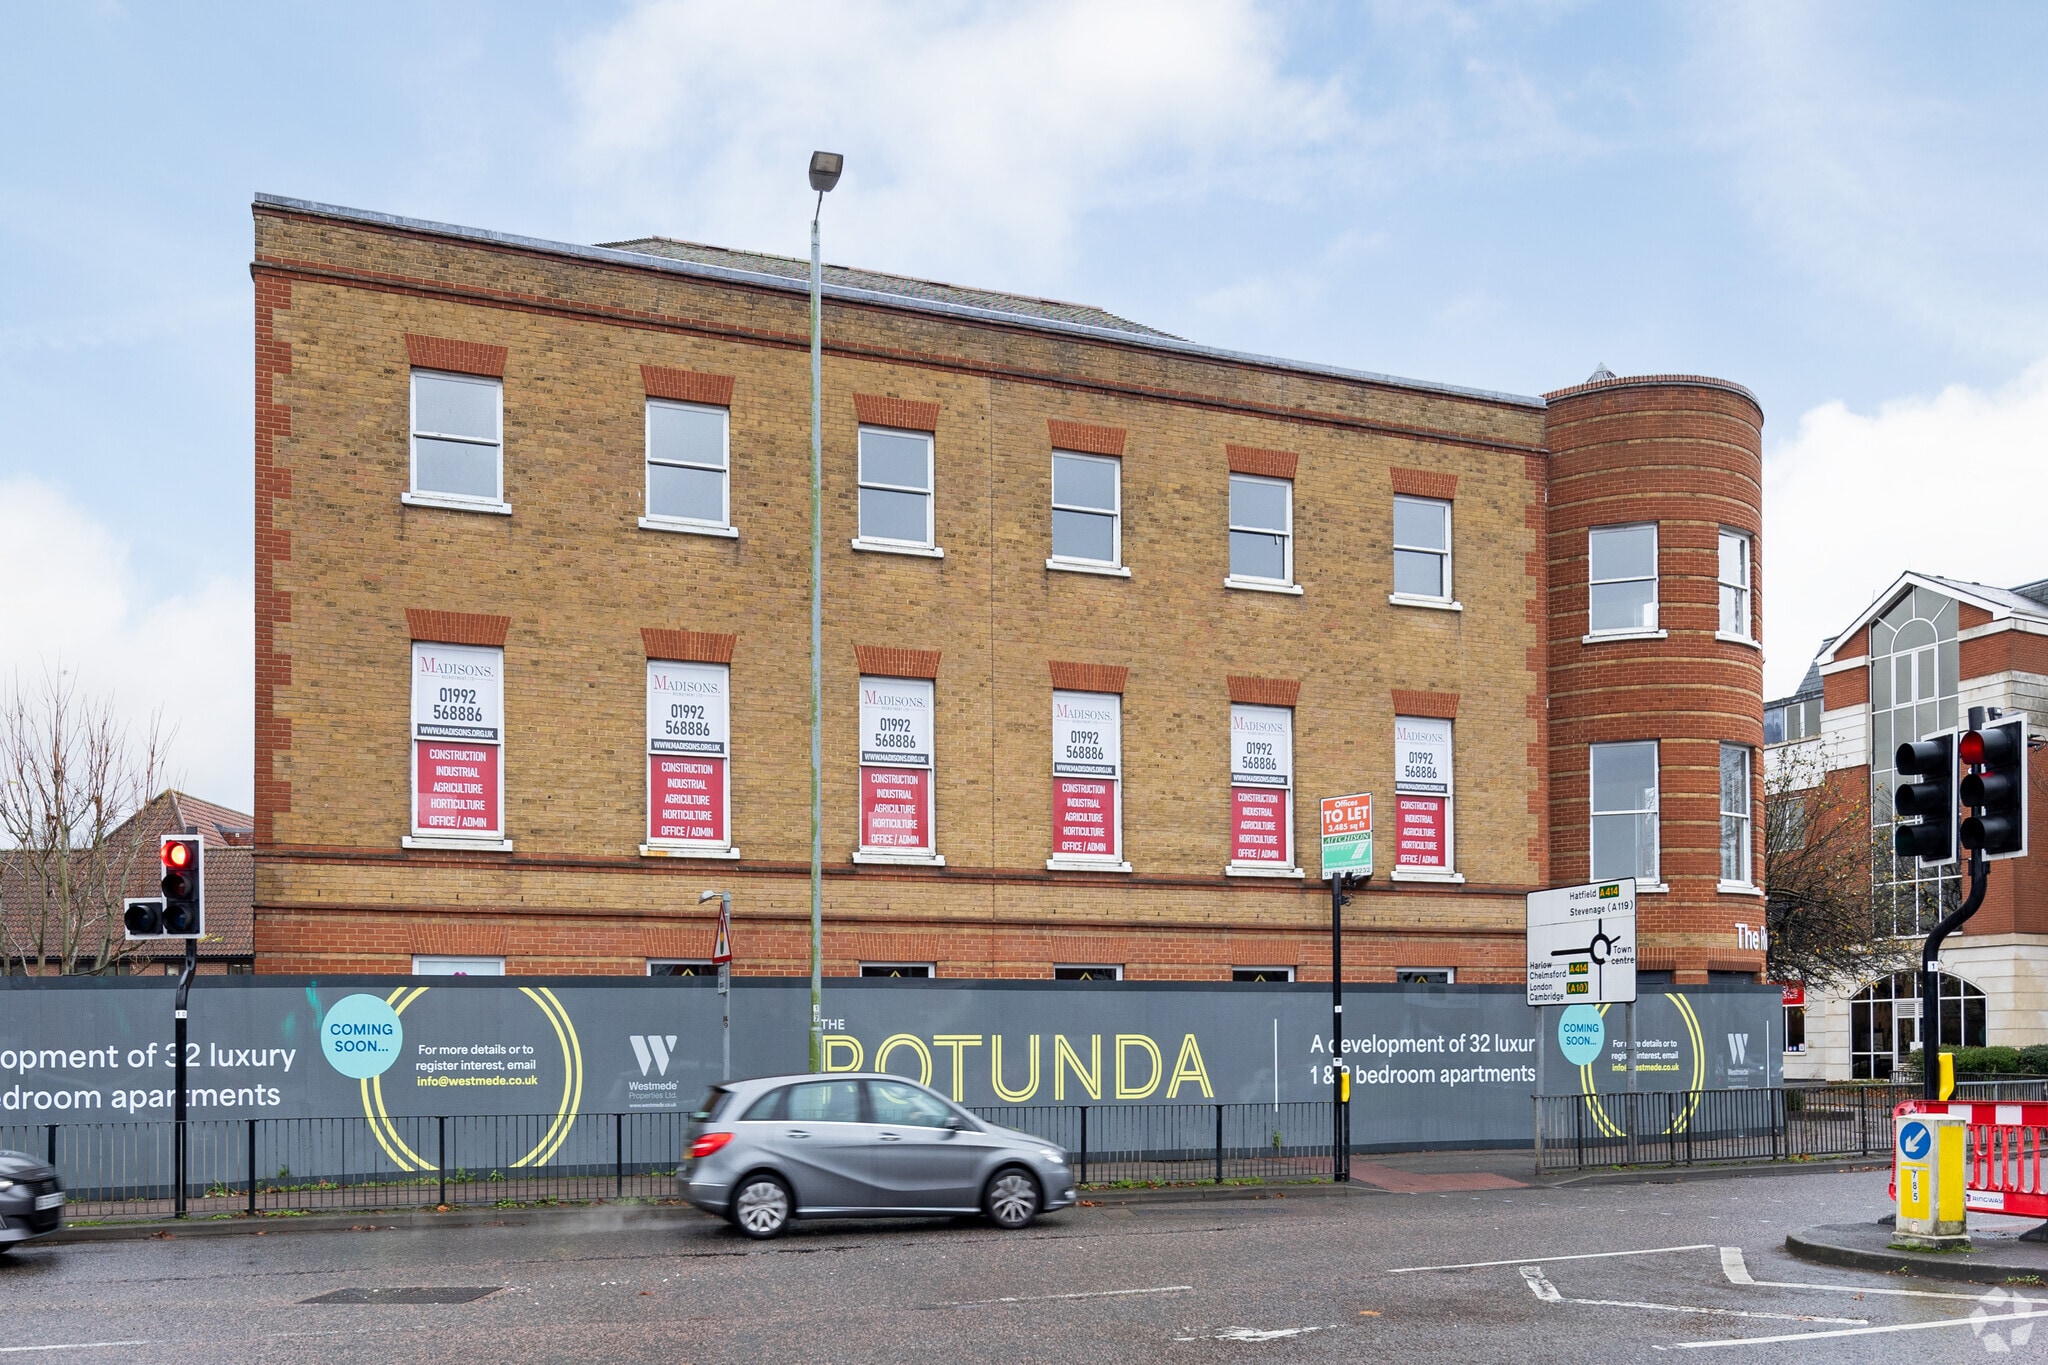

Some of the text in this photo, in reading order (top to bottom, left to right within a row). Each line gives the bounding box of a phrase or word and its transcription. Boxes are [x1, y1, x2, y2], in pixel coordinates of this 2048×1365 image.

[440, 688, 476, 704] 01992
[433, 705, 482, 721] 568886
[671, 704, 704, 719] 01992
[666, 721, 710, 736] 568886
[880, 718, 911, 732] 01992
[420, 726, 494, 738] WWW.MADISONS.ORG.UK
[1071, 731, 1098, 744] 01992
[654, 741, 720, 752] WWW.MADISONS.ORG.UK
[875, 734, 915, 748] 568886
[1067, 746, 1104, 760] 568886
[1247, 742, 1272, 756] 01992
[430, 749, 486, 762] CONSTRUCTION
[1409, 752, 1433, 764] 01992
[662, 762, 712, 774] CONSTRUCTION
[1242, 757, 1276, 770] 568886
[436, 766, 480, 777] INDUSTRIAL
[1405, 766, 1437, 778] 568886
[668, 778, 707, 790] INDUSTRIAL
[871, 774, 918, 785] CONSTRUCTION
[433, 782, 483, 794] AGRICULTURE
[1062, 784, 1105, 794] CONSTRUCTION
[665, 794, 710, 805] AGRICULTURE
[877, 790, 913, 799] INDUSTRIAL
[1238, 793, 1278, 803] CONSTRUCTION
[431, 798, 485, 810] HORTICULTURE
[1067, 798, 1100, 808] INDUSTRIAL
[874, 804, 915, 814] AGRICULTURE
[1242, 807, 1273, 816] INDUSTRIAL
[1324, 806, 1368, 823] TO LET
[662, 810, 712, 821] HORTICULTURE
[1065, 812, 1103, 822] AGRICULTURE
[429, 816, 486, 828] OFFICE / ADMIN
[872, 818, 917, 829] HORTICULTURE
[1241, 820, 1276, 830] AGRICULTURE
[661, 826, 713, 838] OFFICE / ADMIN
[1063, 826, 1104, 836] HORTICULTURE
[871, 834, 893, 844] OFFICE
[899, 835, 919, 845] ADMIN
[1239, 834, 1277, 844] HORTICULTURE
[1325, 833, 1369, 844] AITCHISON
[1062, 842, 1082, 851] OFFICE
[1087, 842, 1106, 852] ADMIN
[1238, 849, 1256, 858] OFFICE
[1261, 849, 1278, 858] ADMIN
[1570, 885, 1618, 900] Hatfield A414
[1570, 900, 1633, 916] Stevenage (A119)
[1735, 923, 1759, 949] The
[1570, 964, 1587, 973] A414
[1530, 970, 1566, 979] Chelmsford
[1567, 982, 1588, 993] (A10)
[1530, 992, 1564, 1001] Cambridge
[330, 1024, 393, 1035] COMING
[821, 1019, 845, 1030] THE
[1564, 1024, 1599, 1033] COMING
[335, 1040, 388, 1052] SOON...
[1310, 1035, 1324, 1053] A
[1449, 1034, 1466, 1053] of
[1470, 1034, 1490, 1052] 32
[1495, 1034, 1535, 1052] luxur
[1566, 1036, 1597, 1046] SOON...
[418, 1045, 533, 1055] For more details or to
[0, 1043, 296, 1074] opment of 32 luxury
[1611, 1051, 1627, 1061] regis
[1637, 1051, 1661, 1059] interest,
[416, 1060, 536, 1073] register interest, email
[1612, 1063, 1679, 1072] infoestmede.co.uk
[1310, 1066, 1318, 1084] 1
[1323, 1065, 1334, 1084] &
[1356, 1065, 1435, 1084] bedroom
[1441, 1065, 1535, 1086] apartments
[417, 1076, 538, 1087] info@westmede.co.uk
[0, 1084, 280, 1114] droom aparments
